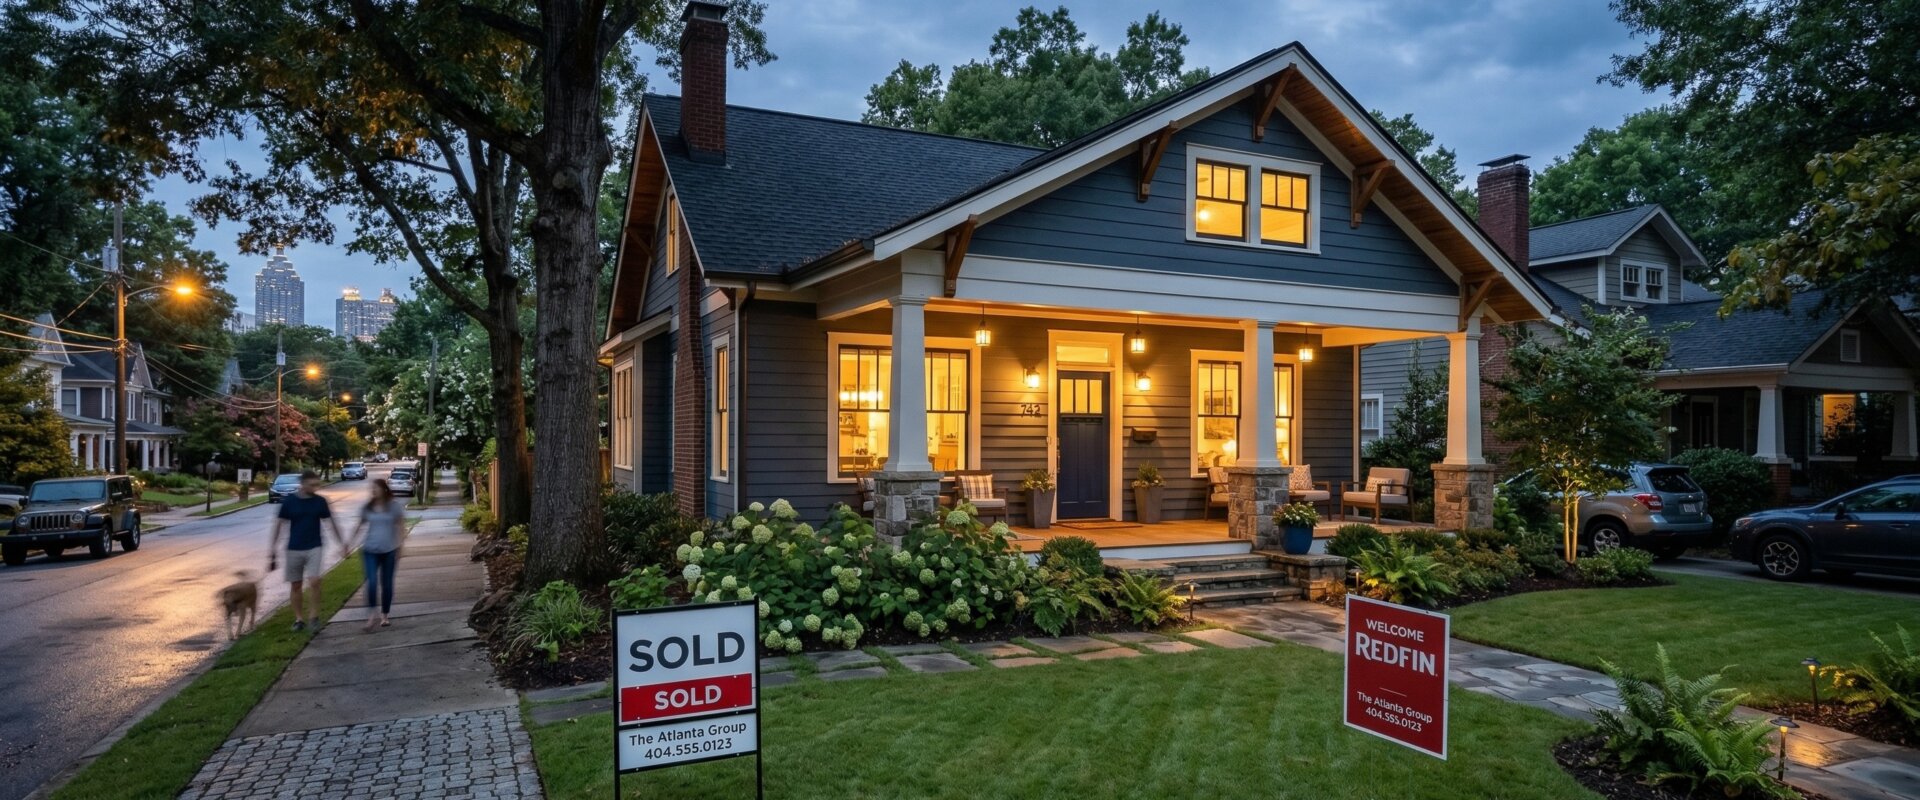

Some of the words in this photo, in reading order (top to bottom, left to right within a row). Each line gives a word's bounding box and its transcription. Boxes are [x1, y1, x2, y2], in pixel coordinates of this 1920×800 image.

[1020, 403, 1042, 418] 742
[1366, 618, 1424, 642] WELCOME
[629, 631, 745, 672] SOLD
[654, 685, 722, 710] SOLD
[1357, 691, 1372, 703] The
[1374, 697, 1403, 714] Atlanta
[1405, 707, 1433, 723] Group
[629, 735, 654, 746] The
[658, 727, 704, 743] Atlanta
[708, 722, 747, 736] Group
[645, 738, 732, 759] 404.555.0123
